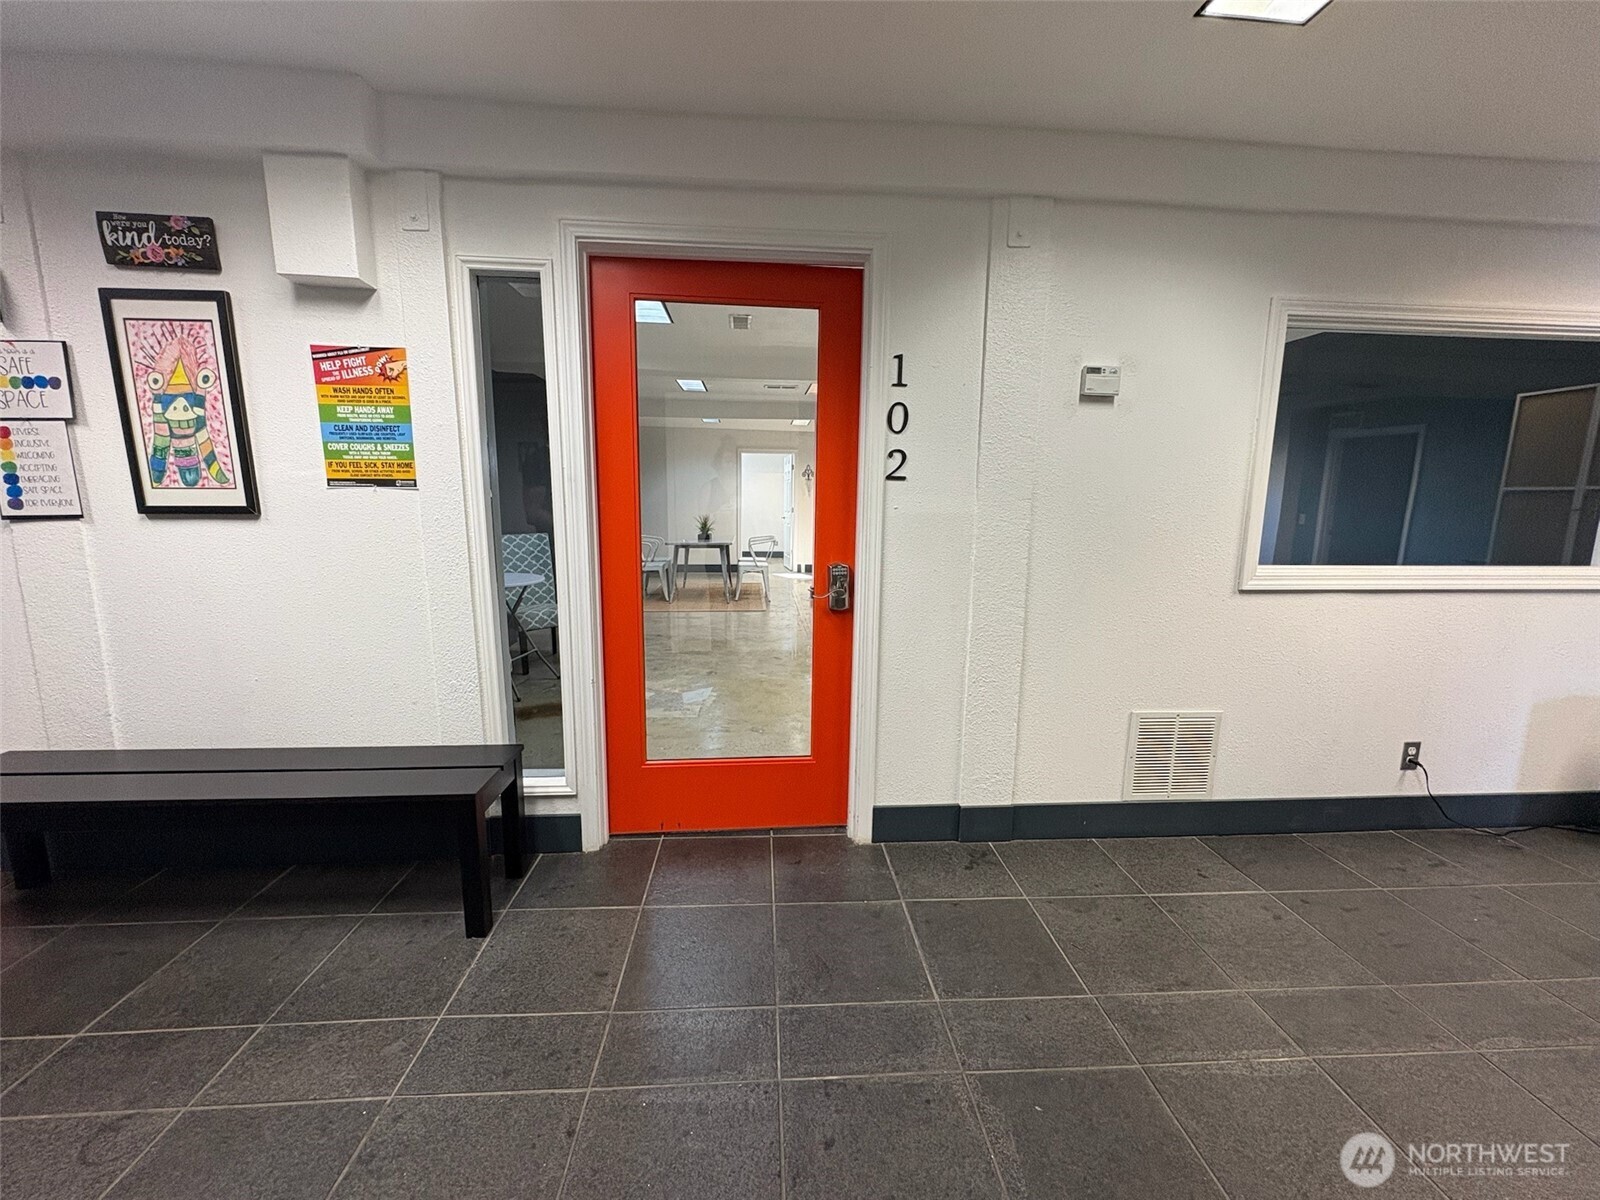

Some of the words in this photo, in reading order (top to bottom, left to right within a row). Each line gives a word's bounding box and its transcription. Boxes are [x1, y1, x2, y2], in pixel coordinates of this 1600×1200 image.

[102, 220, 161, 247] kind
[162, 233, 211, 248] today?
[320, 360, 341, 371] HELP
[342, 356, 366, 368] FIGHT
[375, 354, 390, 373] POW!
[341, 366, 374, 379] ILLNESS
